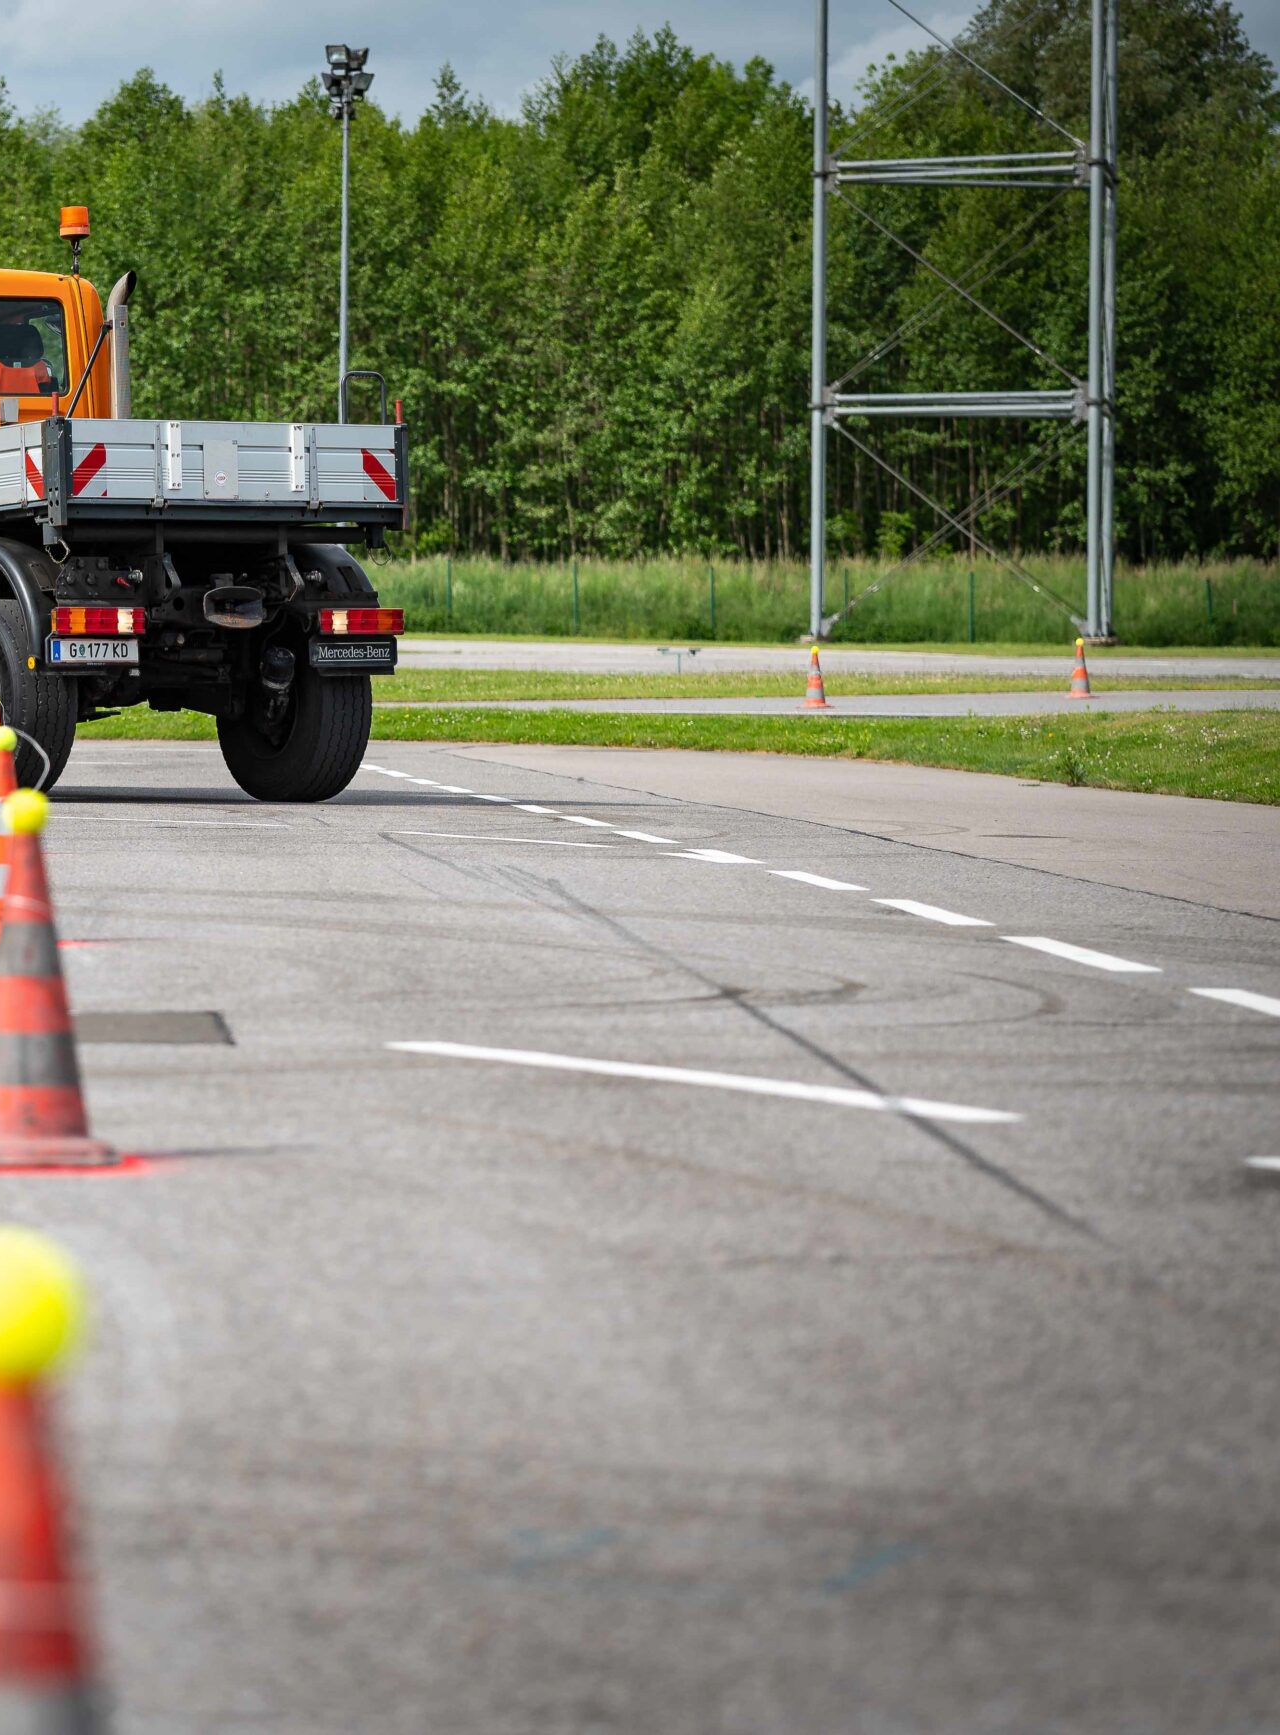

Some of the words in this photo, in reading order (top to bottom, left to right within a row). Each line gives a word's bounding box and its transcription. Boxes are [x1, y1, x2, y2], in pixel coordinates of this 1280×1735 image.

[69, 643, 77, 658] G
[87, 643, 109, 658] 177
[112, 643, 128, 658] KD
[319, 645, 390, 659] Mercedes-Benz
